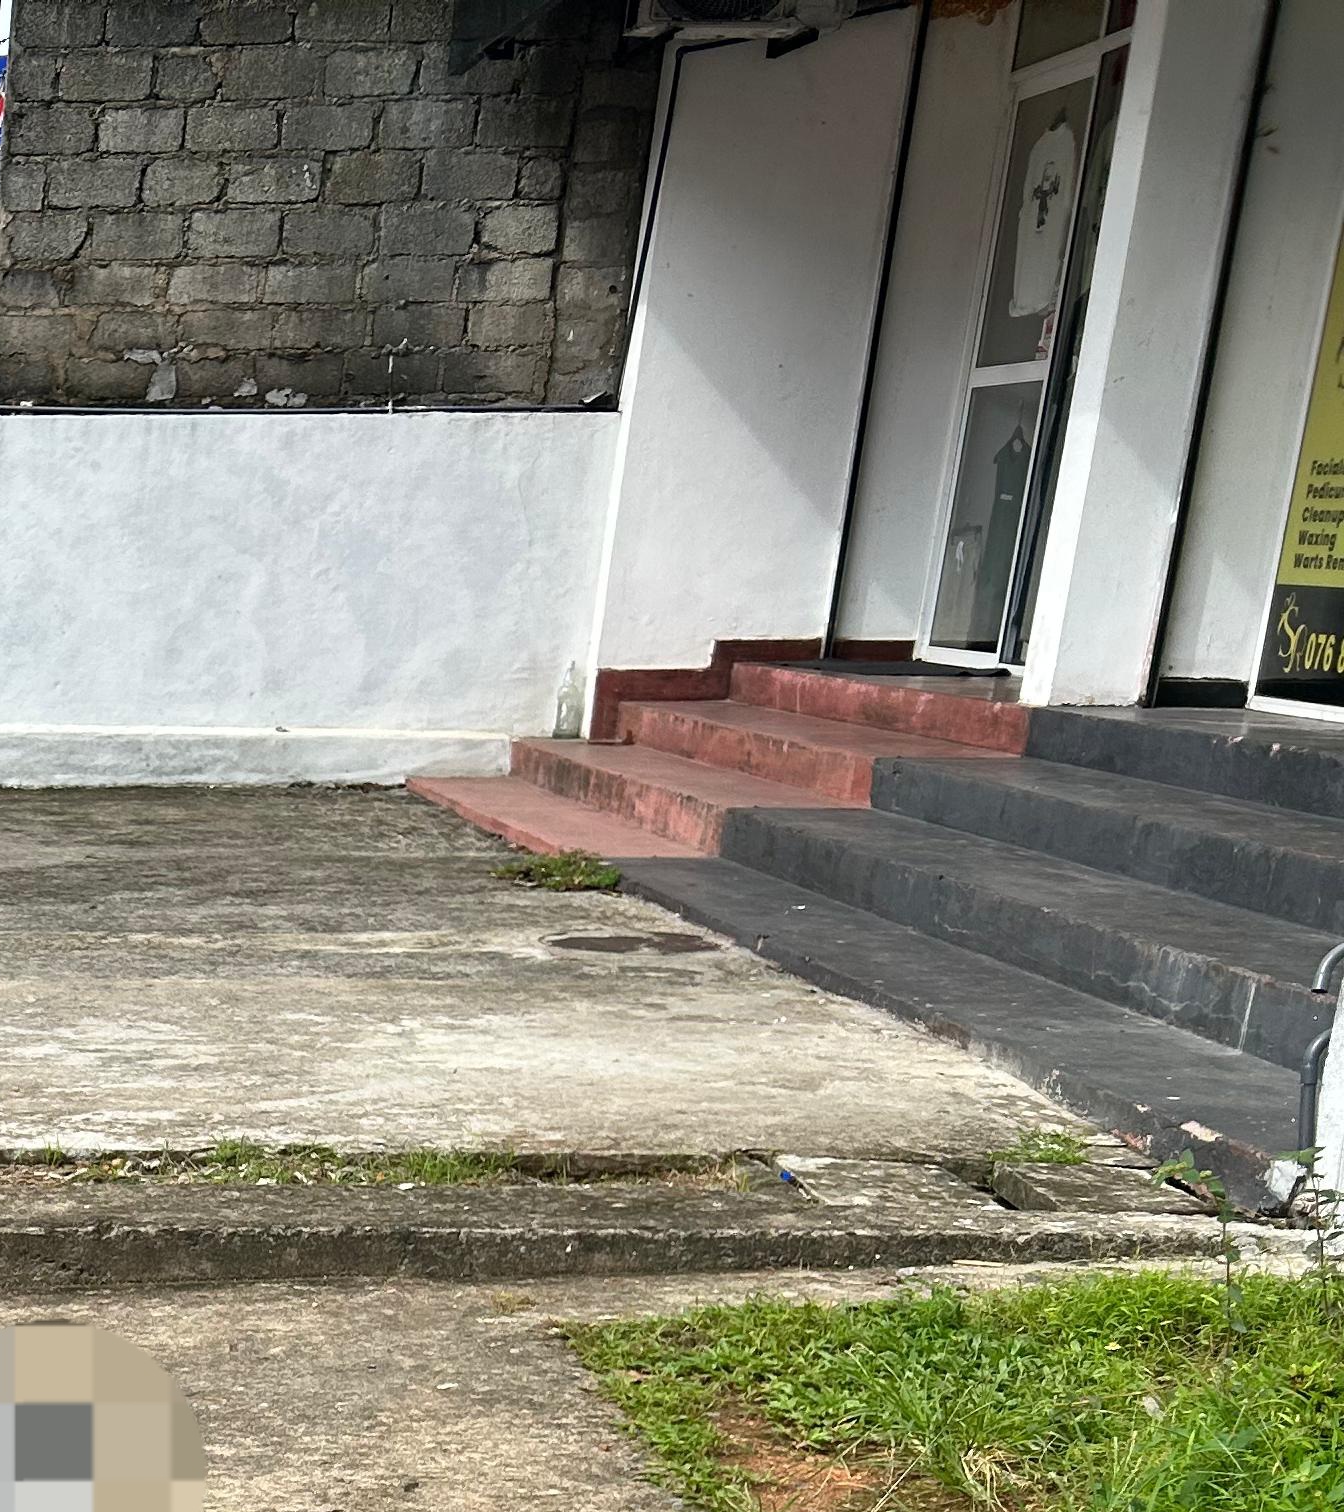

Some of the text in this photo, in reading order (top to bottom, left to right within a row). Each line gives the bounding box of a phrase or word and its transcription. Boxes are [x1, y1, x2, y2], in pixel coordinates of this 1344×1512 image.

[1298, 529, 1337, 552] Waxing
[1293, 553, 1324, 570] Warts
[1304, 632, 1336, 672] 076
